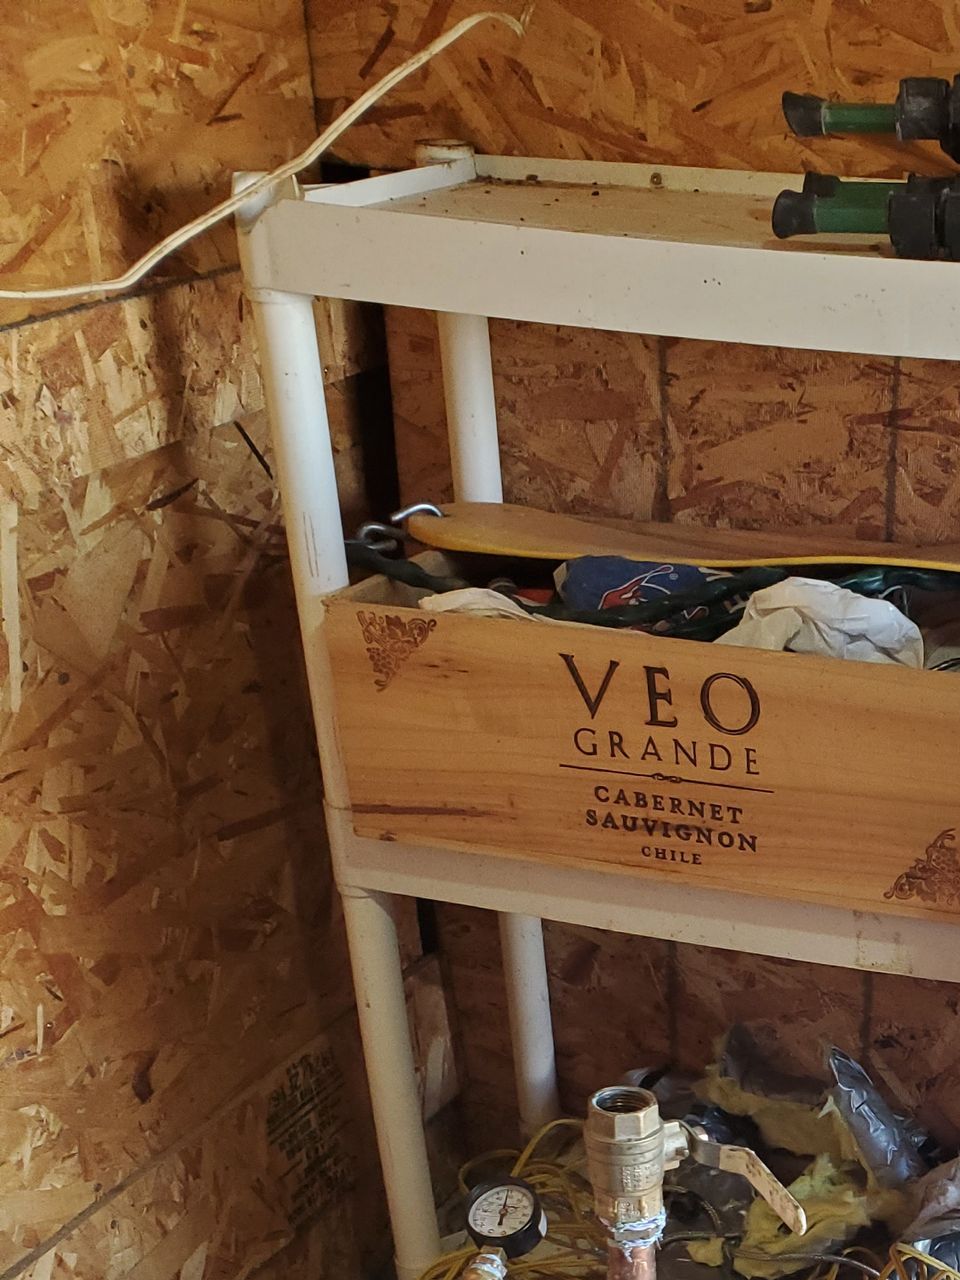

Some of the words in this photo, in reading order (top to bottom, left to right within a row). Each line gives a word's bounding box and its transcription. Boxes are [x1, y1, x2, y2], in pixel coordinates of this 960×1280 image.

[559, 653, 760, 736] VEO
[574, 727, 760, 775] GRANDE
[594, 786, 743, 824] CABERNET
[586, 809, 758, 853] SAUVIGNON
[641, 846, 702, 865] CHILE
